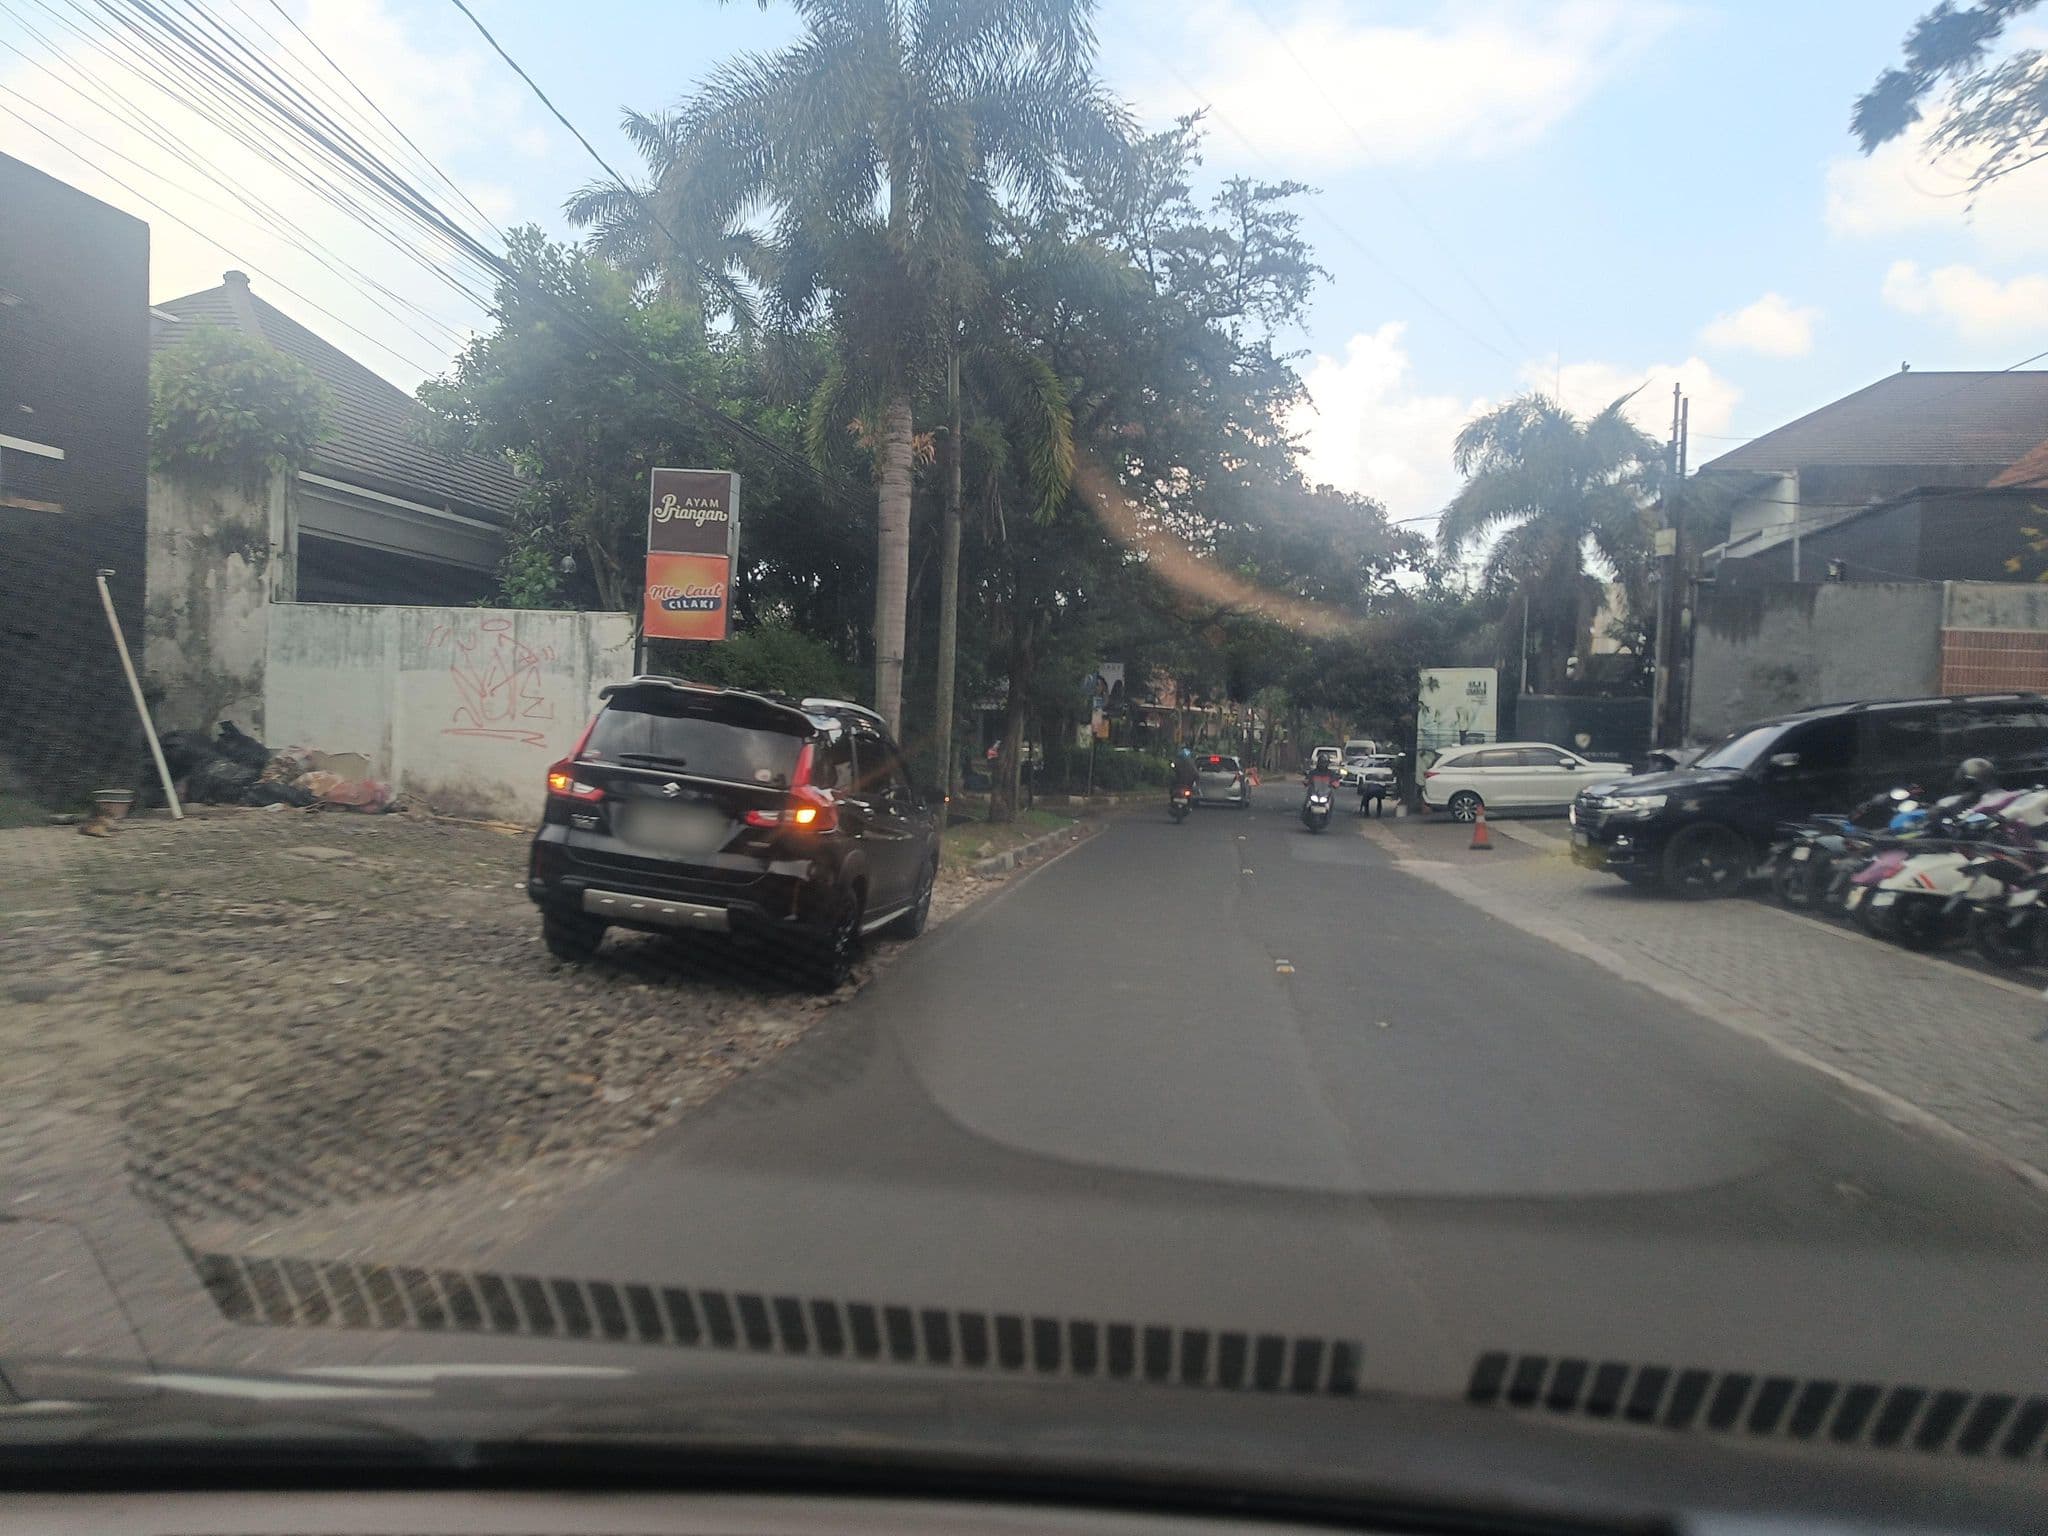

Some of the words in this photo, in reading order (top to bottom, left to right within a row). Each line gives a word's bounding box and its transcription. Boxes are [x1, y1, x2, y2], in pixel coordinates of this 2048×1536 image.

[685, 497, 720, 508] AYAM
[654, 493, 728, 527] Priangan
[650, 584, 681, 600] Mie
[668, 599, 714, 609] CILAKI
